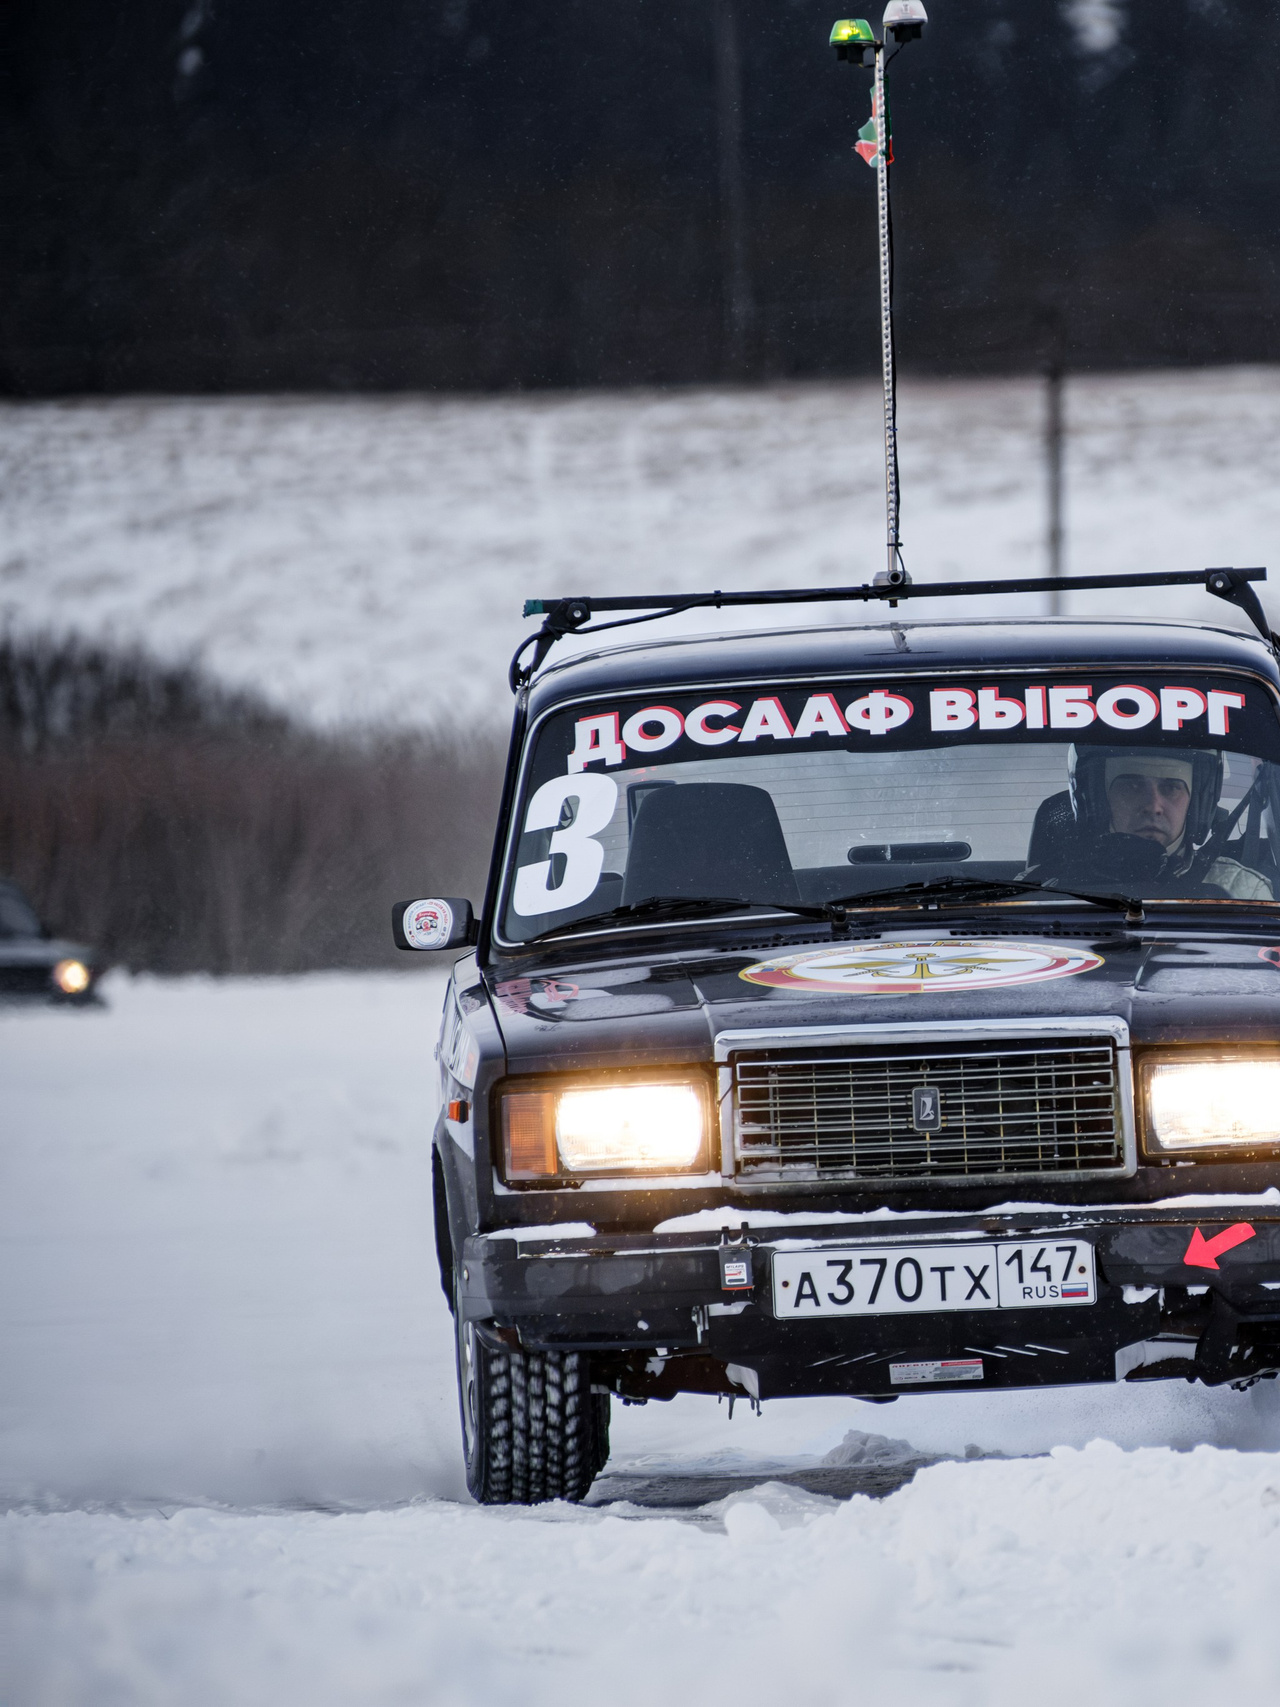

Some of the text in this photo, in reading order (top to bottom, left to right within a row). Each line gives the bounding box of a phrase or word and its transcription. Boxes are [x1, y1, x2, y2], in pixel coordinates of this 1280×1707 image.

[568, 684, 1246, 772] ДОСААФ ВЫБОРГ
[512, 772, 618, 917] 3
[1004, 1246, 1077, 1284] 147
[1022, 1285, 1061, 1299] RUS
